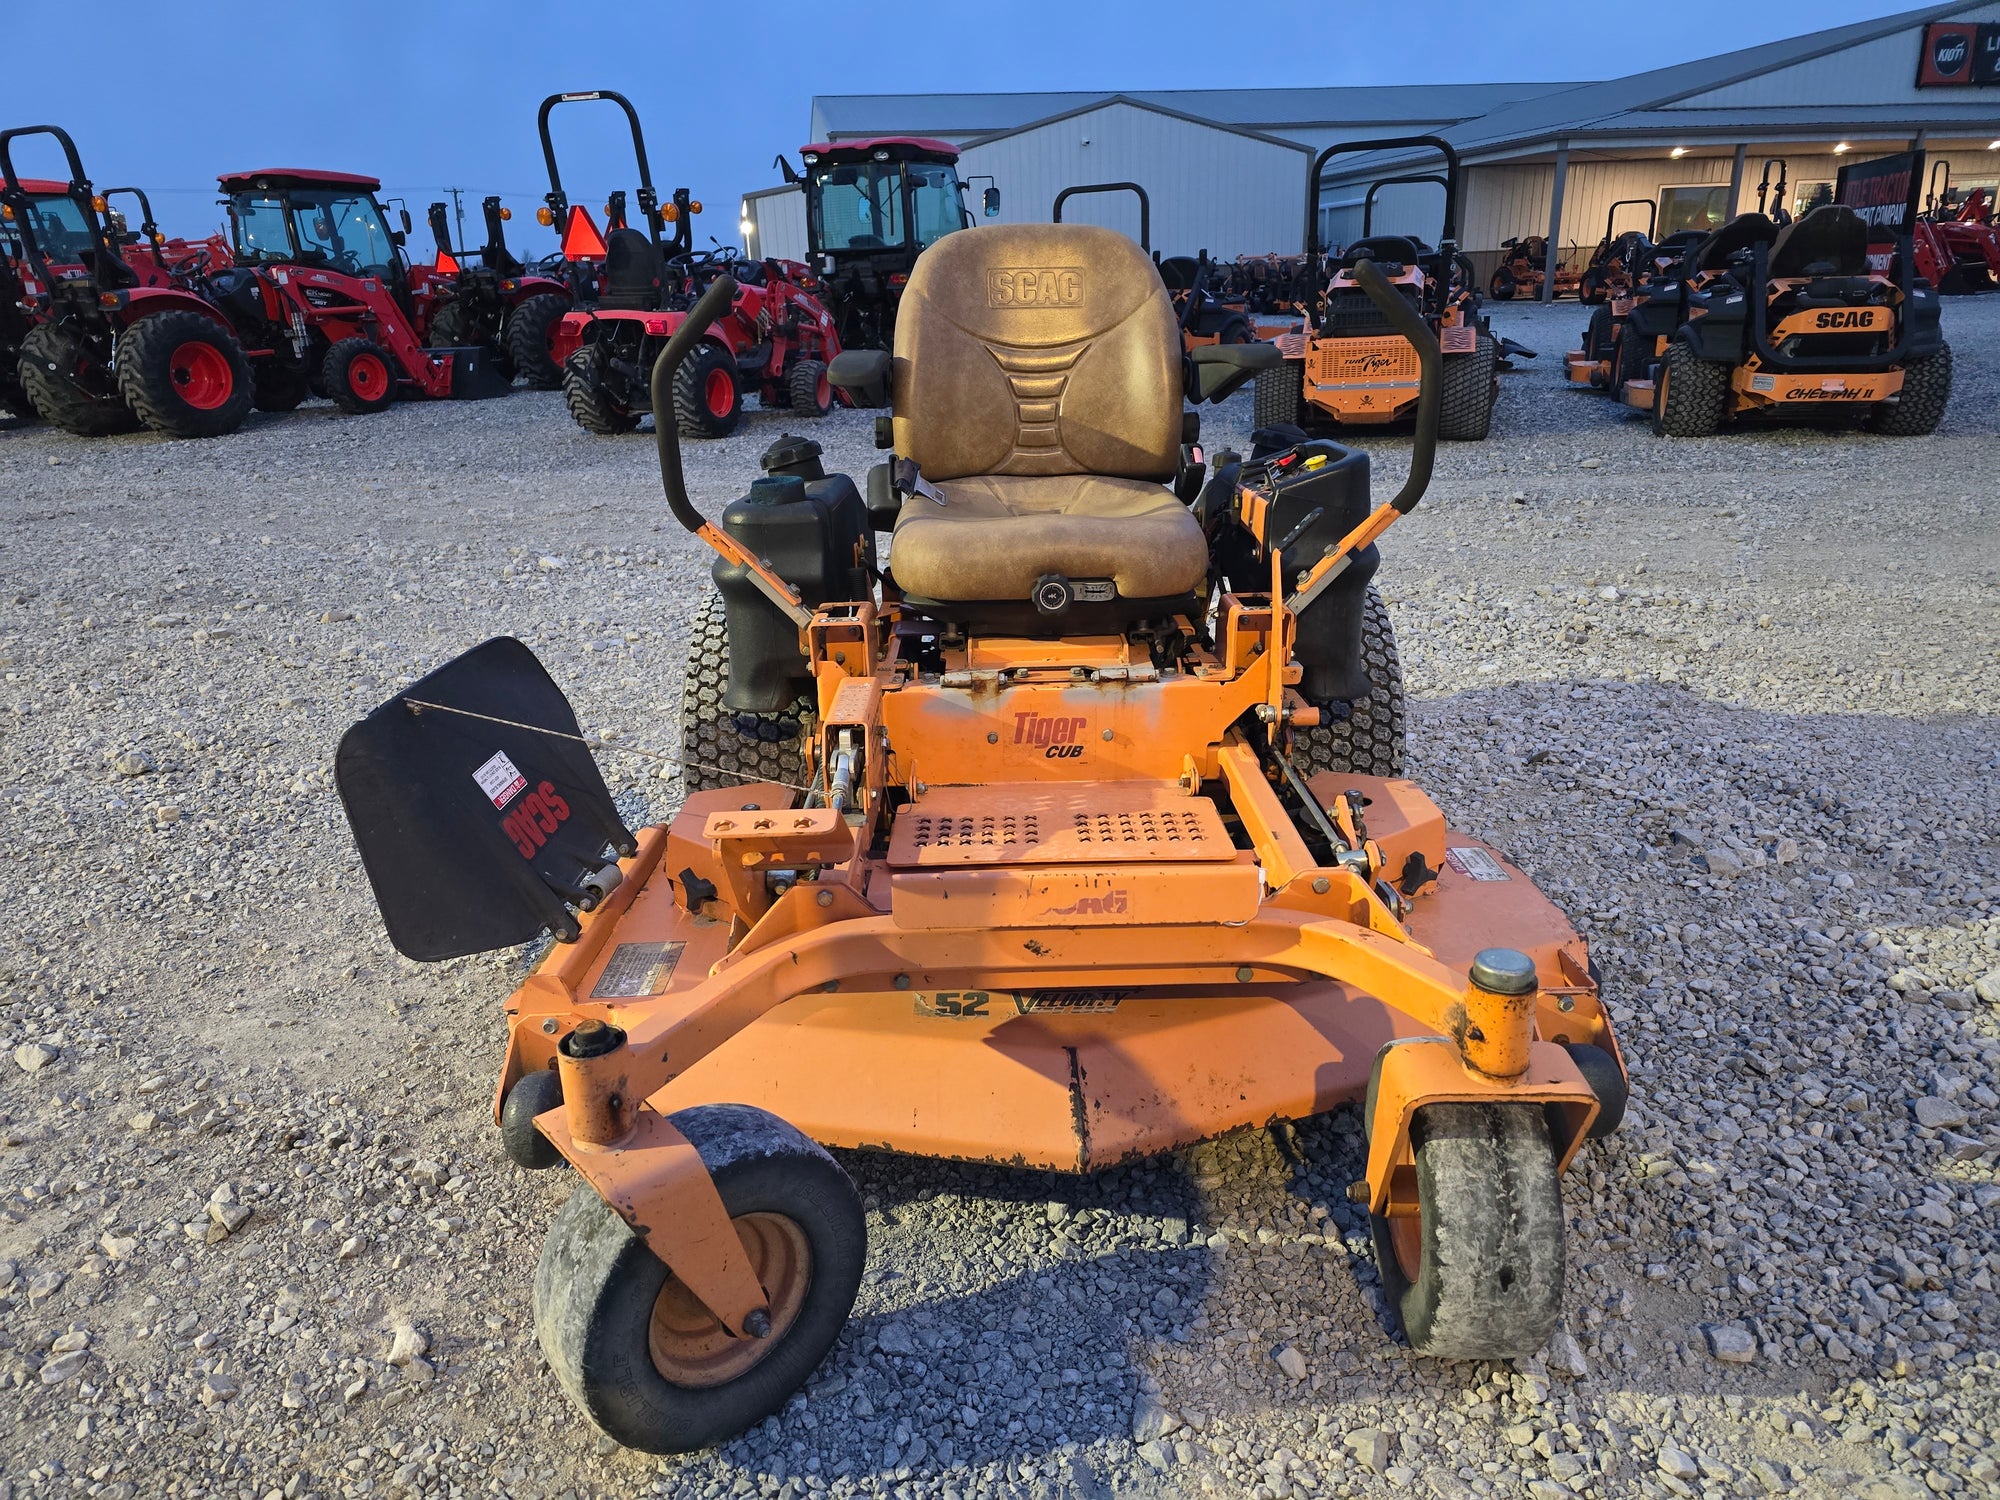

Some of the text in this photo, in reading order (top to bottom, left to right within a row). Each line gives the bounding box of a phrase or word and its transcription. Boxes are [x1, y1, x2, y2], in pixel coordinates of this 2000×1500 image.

[1937, 43, 1965, 62] KIOTI
[991, 271, 1083, 305] SCAG
[1816, 311, 1874, 329] SCAG
[1361, 354, 1392, 373] Tiger
[1013, 711, 1087, 750] Tiger
[1045, 745, 1084, 758] CUB
[502, 780, 570, 860] SCAG
[935, 992, 990, 1017] 52
